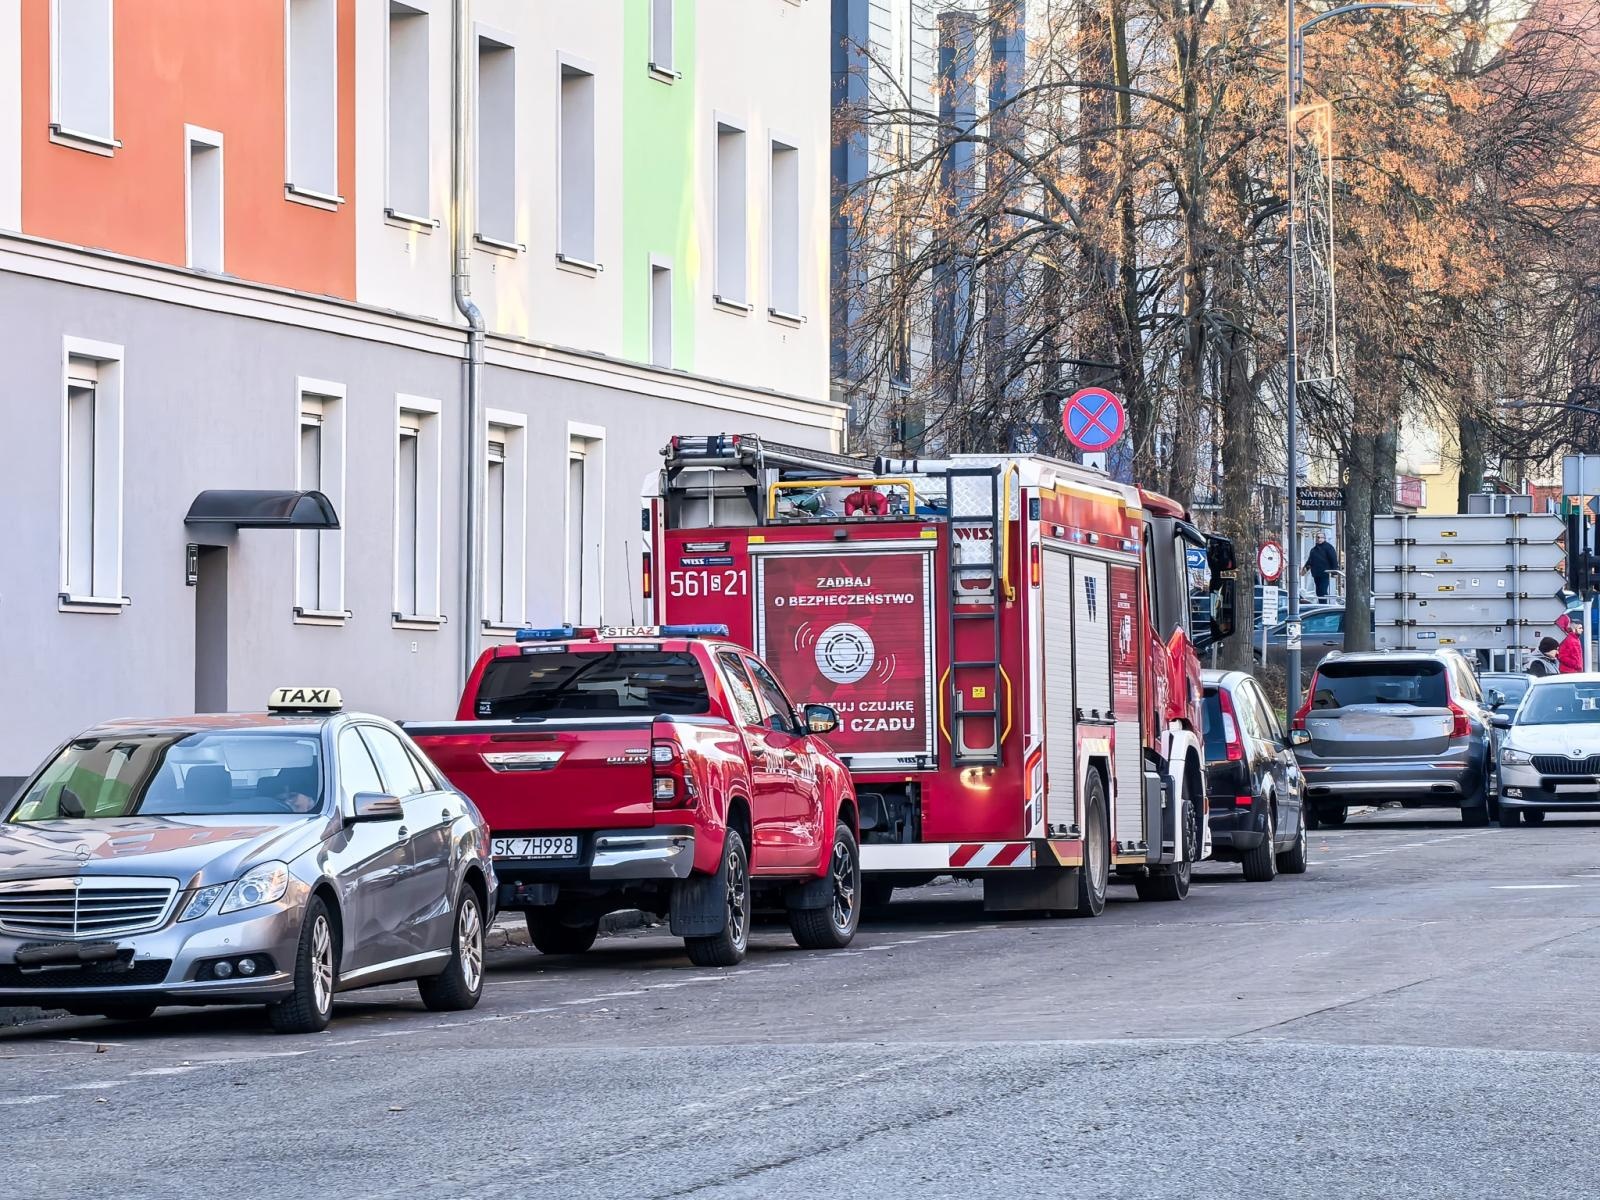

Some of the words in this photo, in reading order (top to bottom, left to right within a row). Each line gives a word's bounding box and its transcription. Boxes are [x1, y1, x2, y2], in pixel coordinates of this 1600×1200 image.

[670, 571, 708, 597] 561
[724, 569, 747, 596] 21
[816, 576, 872, 588] ZADBAJ
[774, 596, 785, 607] O
[789, 592, 915, 607] BEZPIECZEŃSTWO
[279, 689, 331, 703] TAXI
[796, 702, 855, 713] MTUJ
[859, 701, 915, 714] CZUJKĘ
[850, 717, 916, 732] CZADU
[494, 839, 516, 856] SK
[522, 837, 574, 855] 7H998
